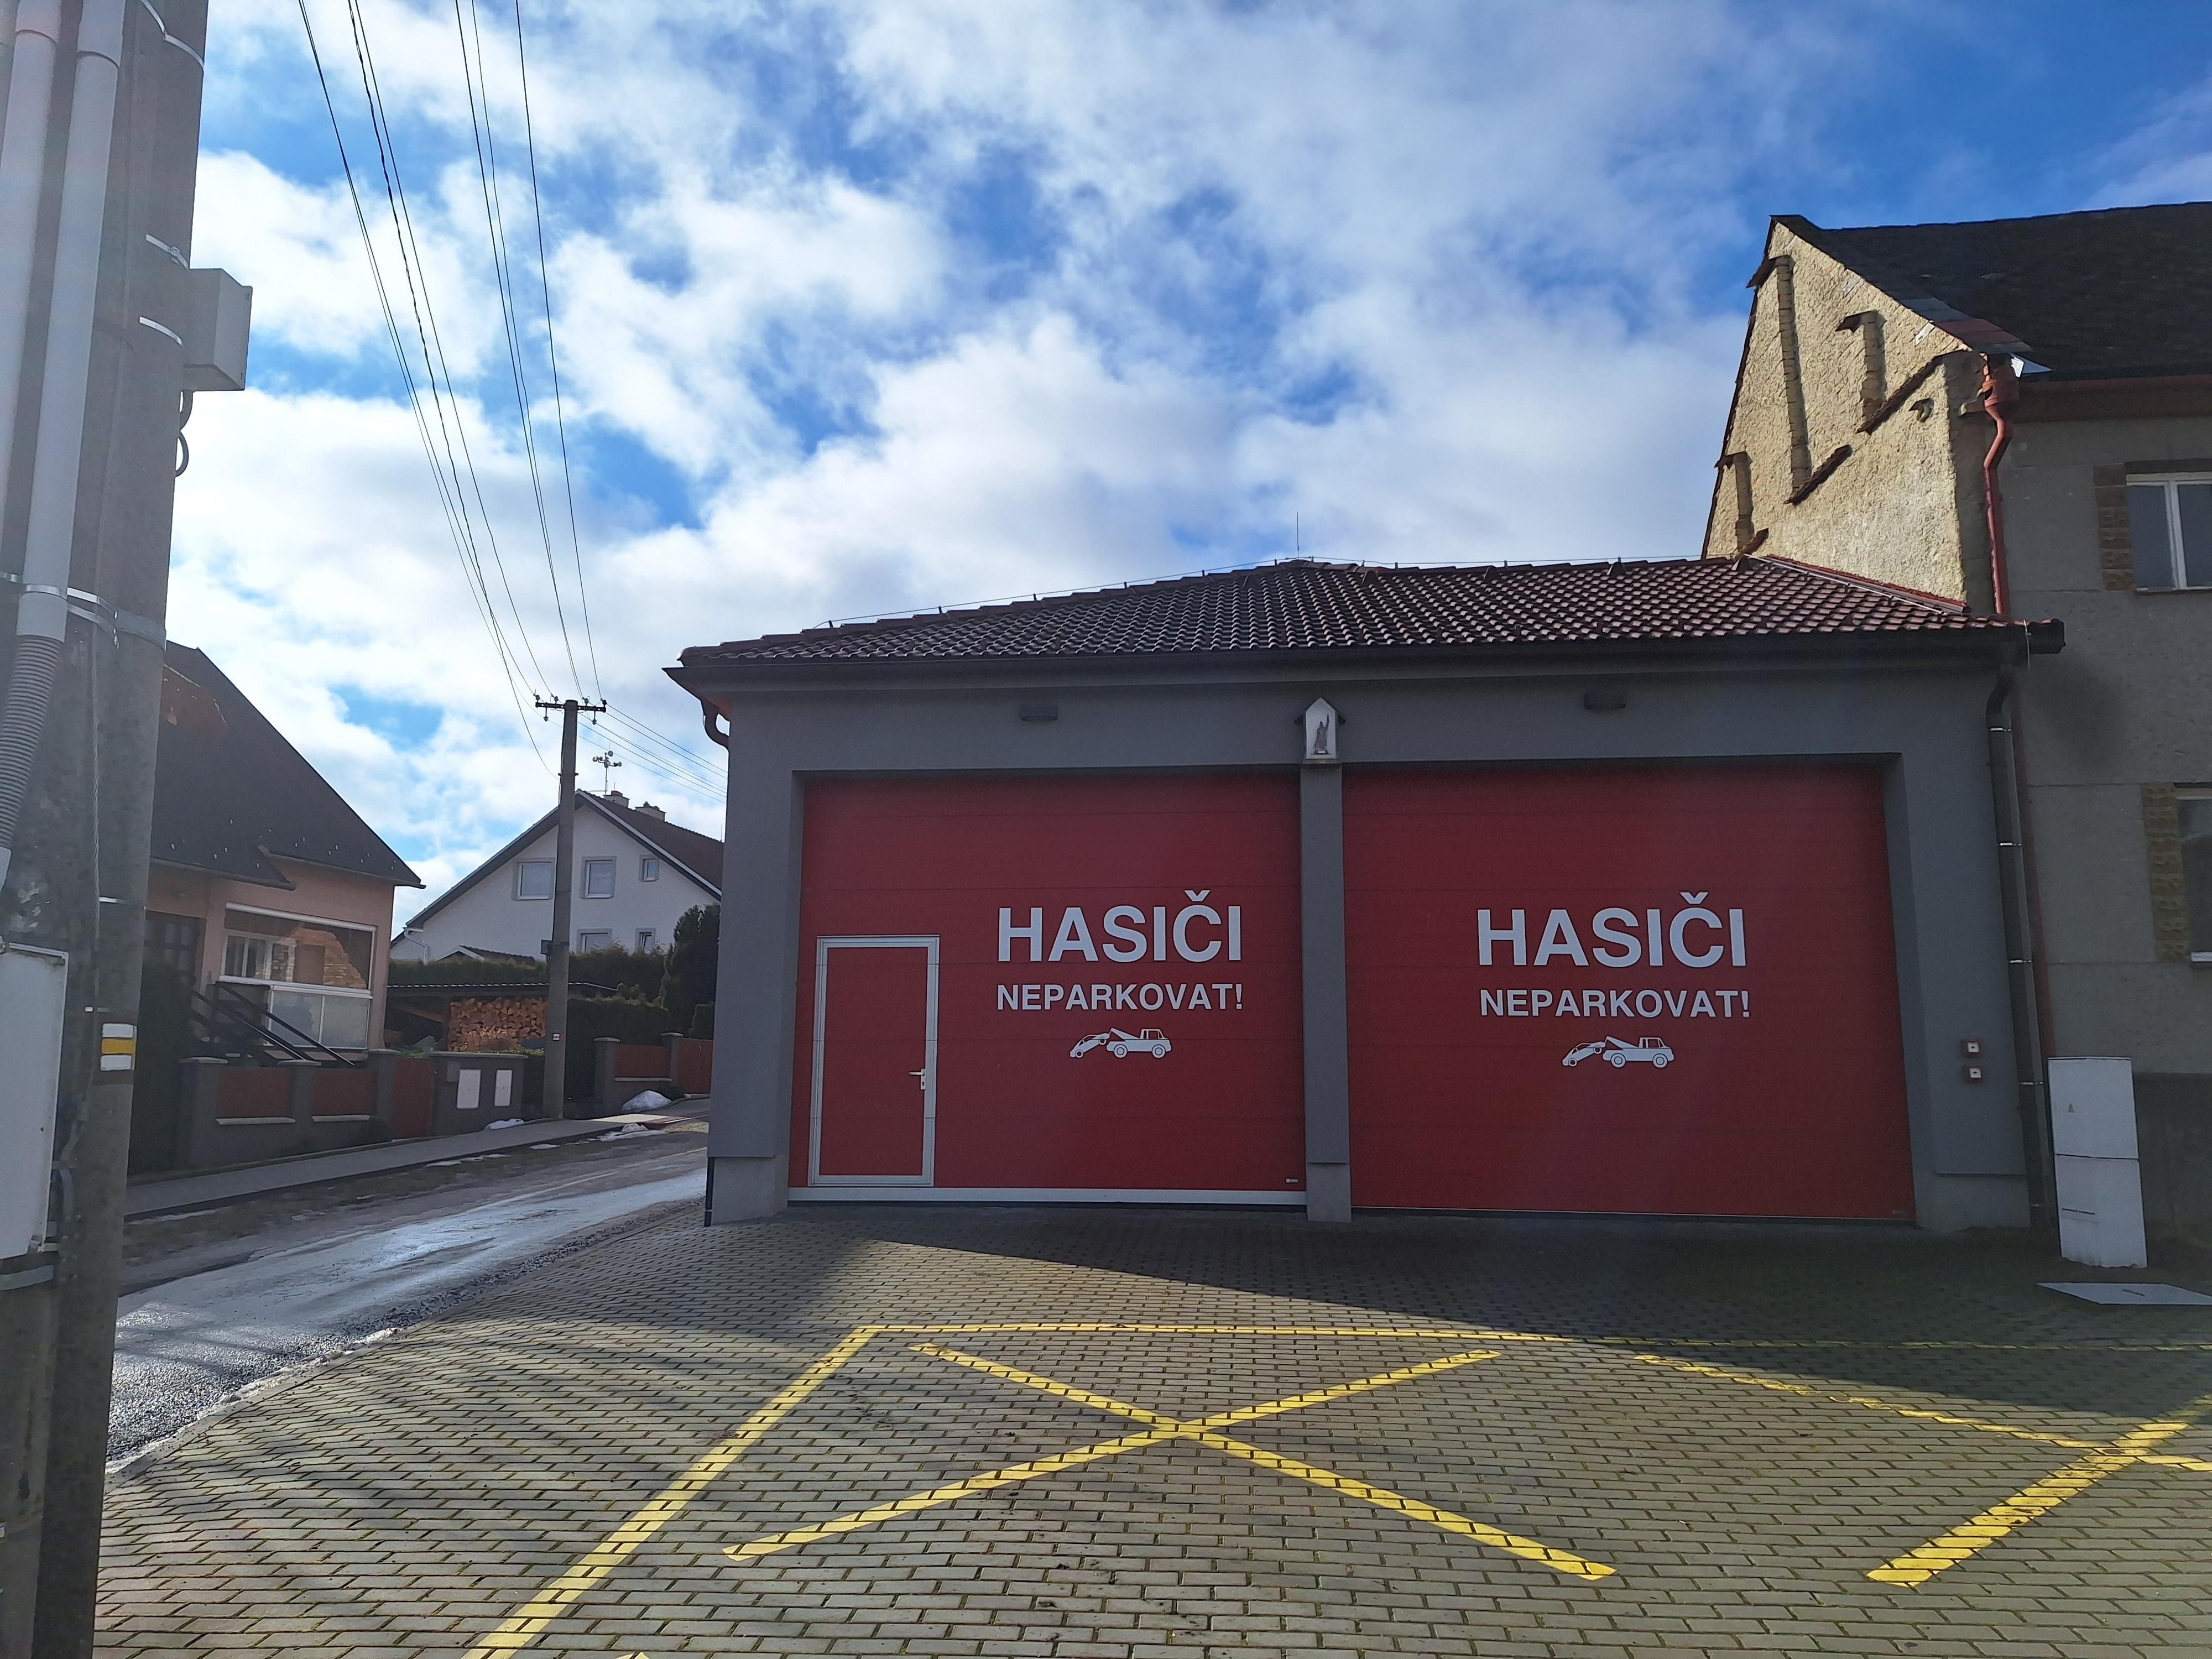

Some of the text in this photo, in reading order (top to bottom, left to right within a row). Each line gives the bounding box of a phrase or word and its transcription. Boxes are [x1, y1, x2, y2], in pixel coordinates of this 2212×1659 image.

[998, 890, 1241, 963] HASIČI
[1477, 892, 1746, 968] HASIČI
[997, 983, 1243, 1010] NEPARKOVAT!
[1480, 989, 1750, 1018] NEPARKOVAT!
